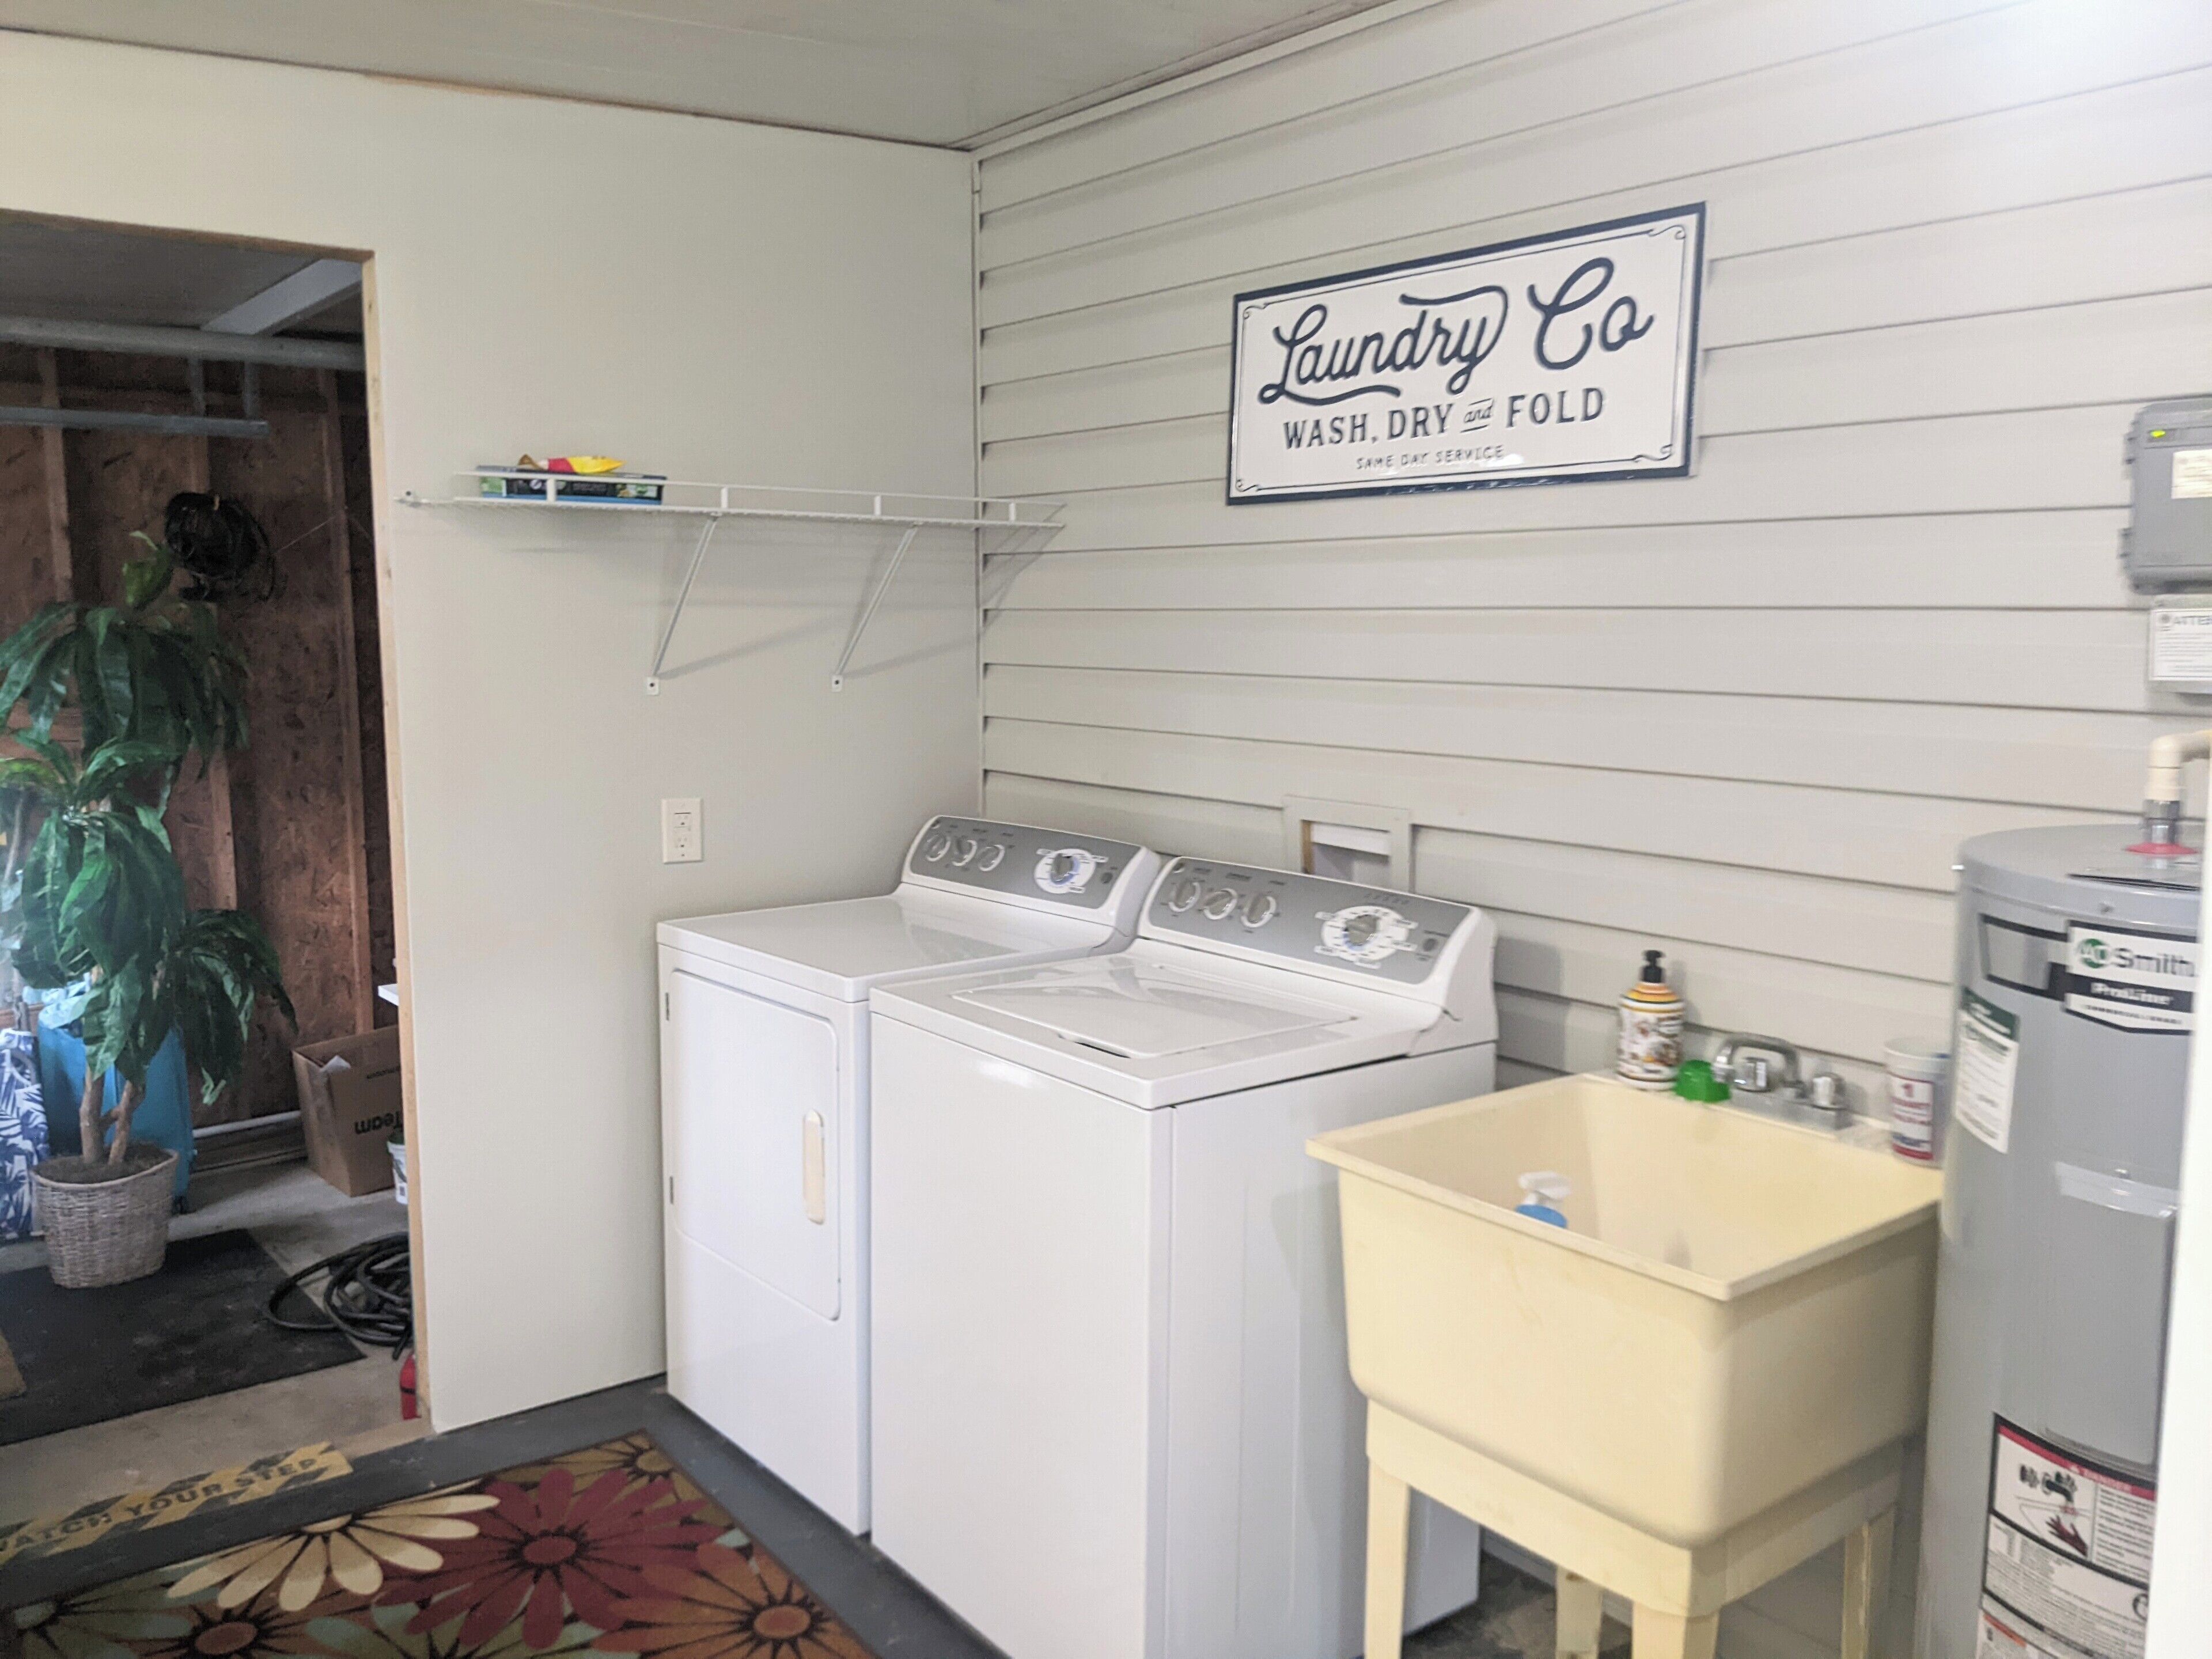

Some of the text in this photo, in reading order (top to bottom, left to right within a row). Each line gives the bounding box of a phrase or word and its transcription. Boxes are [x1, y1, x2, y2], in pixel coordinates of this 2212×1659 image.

[1257, 257, 1655, 406] Laundry Co
[1387, 403, 1454, 440] DRY
[1463, 402, 1494, 423] and
[1505, 387, 1606, 429] FOLD
[1355, 444, 1504, 470] SAME DAY SERVICE
[124, 1483, 223, 1517] YOUR
[234, 1458, 317, 1487] STEP
